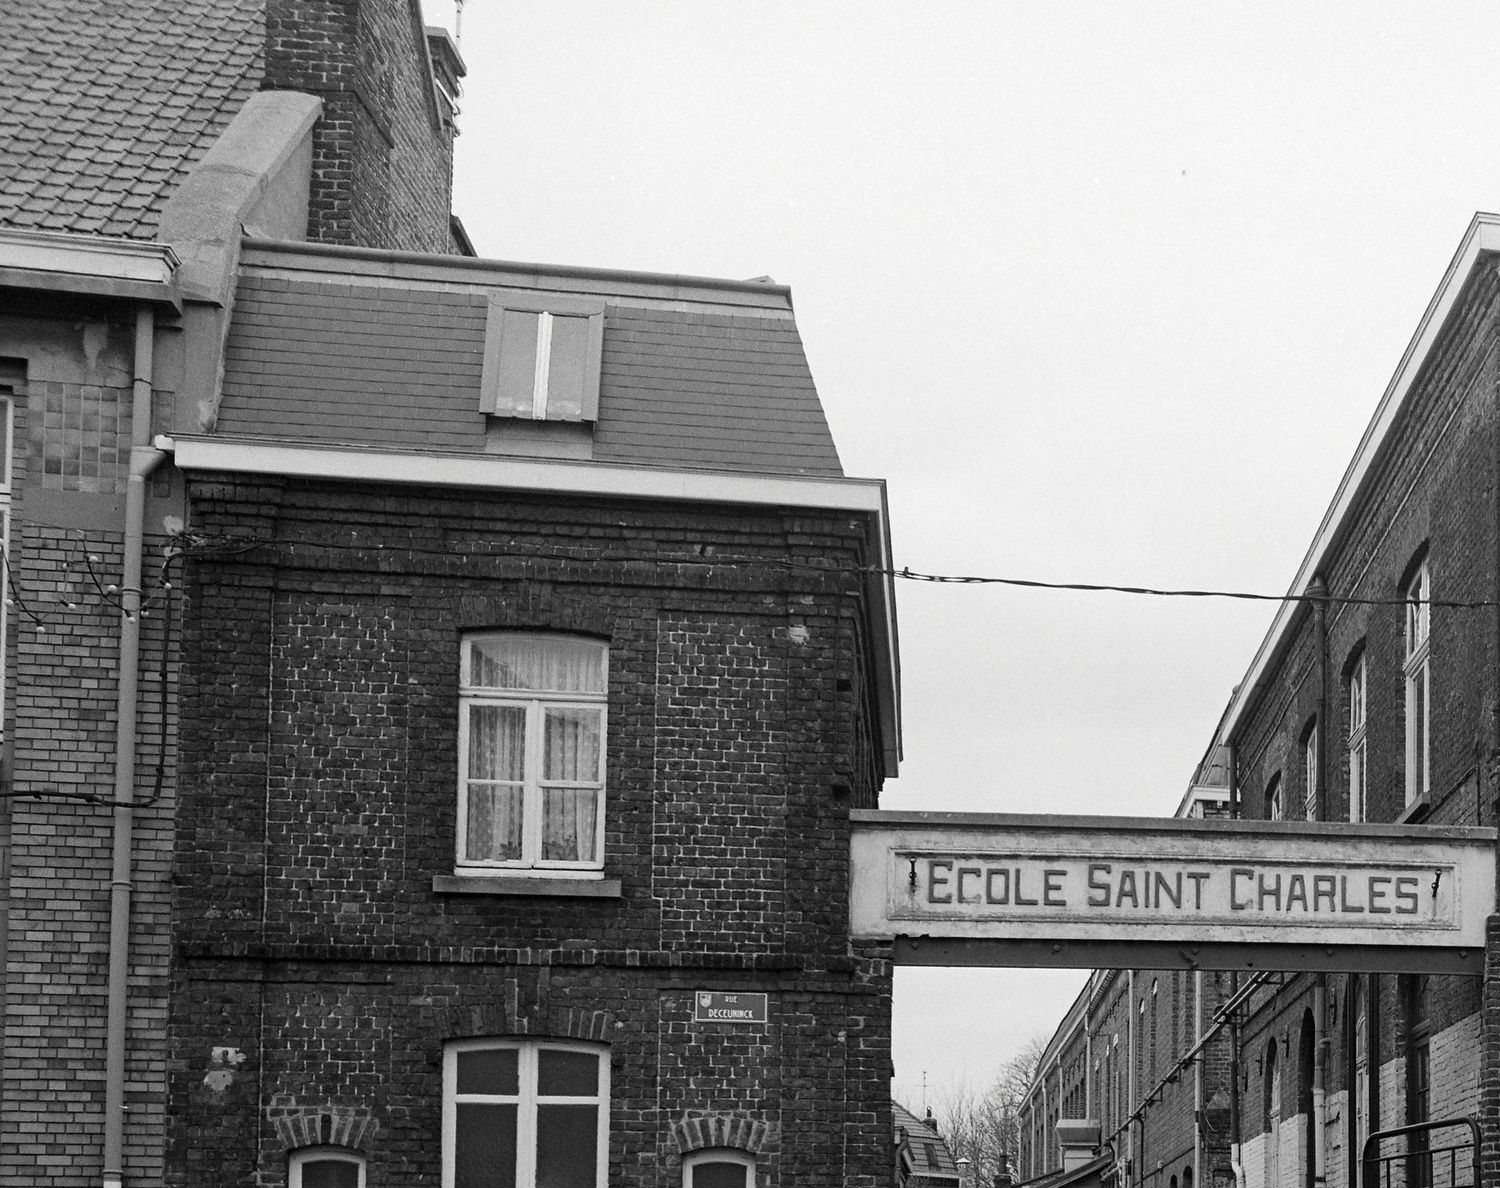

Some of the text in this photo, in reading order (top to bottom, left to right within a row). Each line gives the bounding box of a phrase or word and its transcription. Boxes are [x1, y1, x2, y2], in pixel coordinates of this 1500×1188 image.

[928, 860, 1419, 915] ECOLE SAINT CHARLES
[725, 995, 737, 1003] RUE
[708, 1008, 754, 1018] DECEUNINCK
